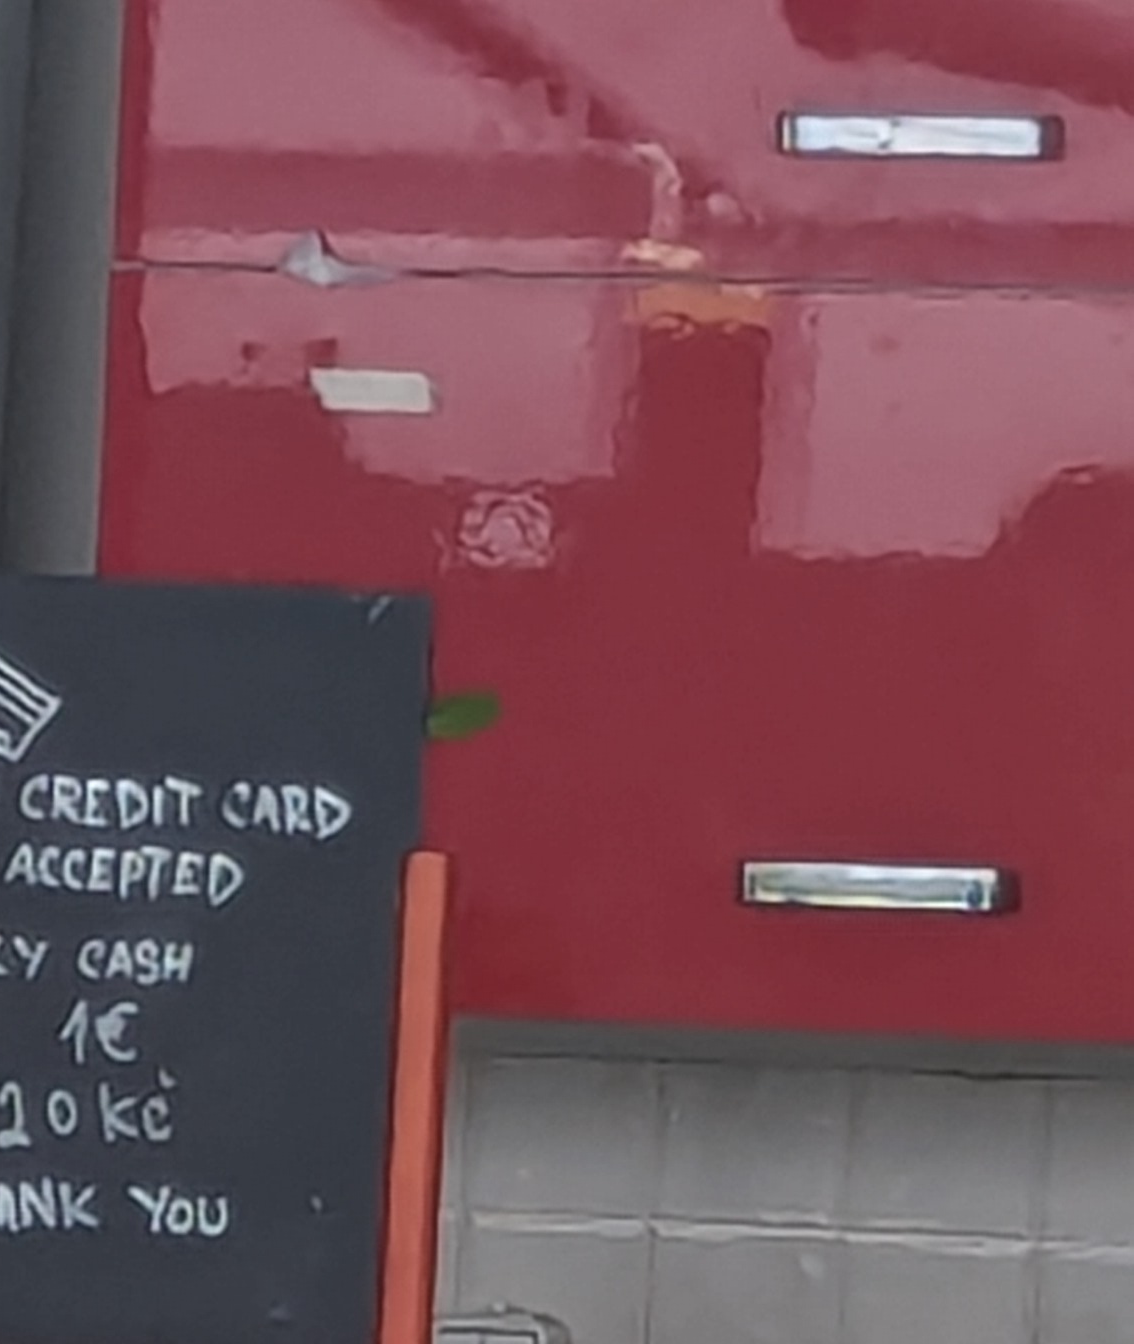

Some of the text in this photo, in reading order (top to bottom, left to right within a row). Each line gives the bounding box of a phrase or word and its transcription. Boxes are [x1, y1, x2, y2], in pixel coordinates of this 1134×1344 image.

[19, 774, 201, 828] CREDIT
[221, 780, 352, 840] CARD
[3, 842, 244, 906] ACCEPTED
[77, 939, 194, 985] CASH
[59, 999, 139, 1064] 1€
[129, 1185, 230, 1236] YOU
